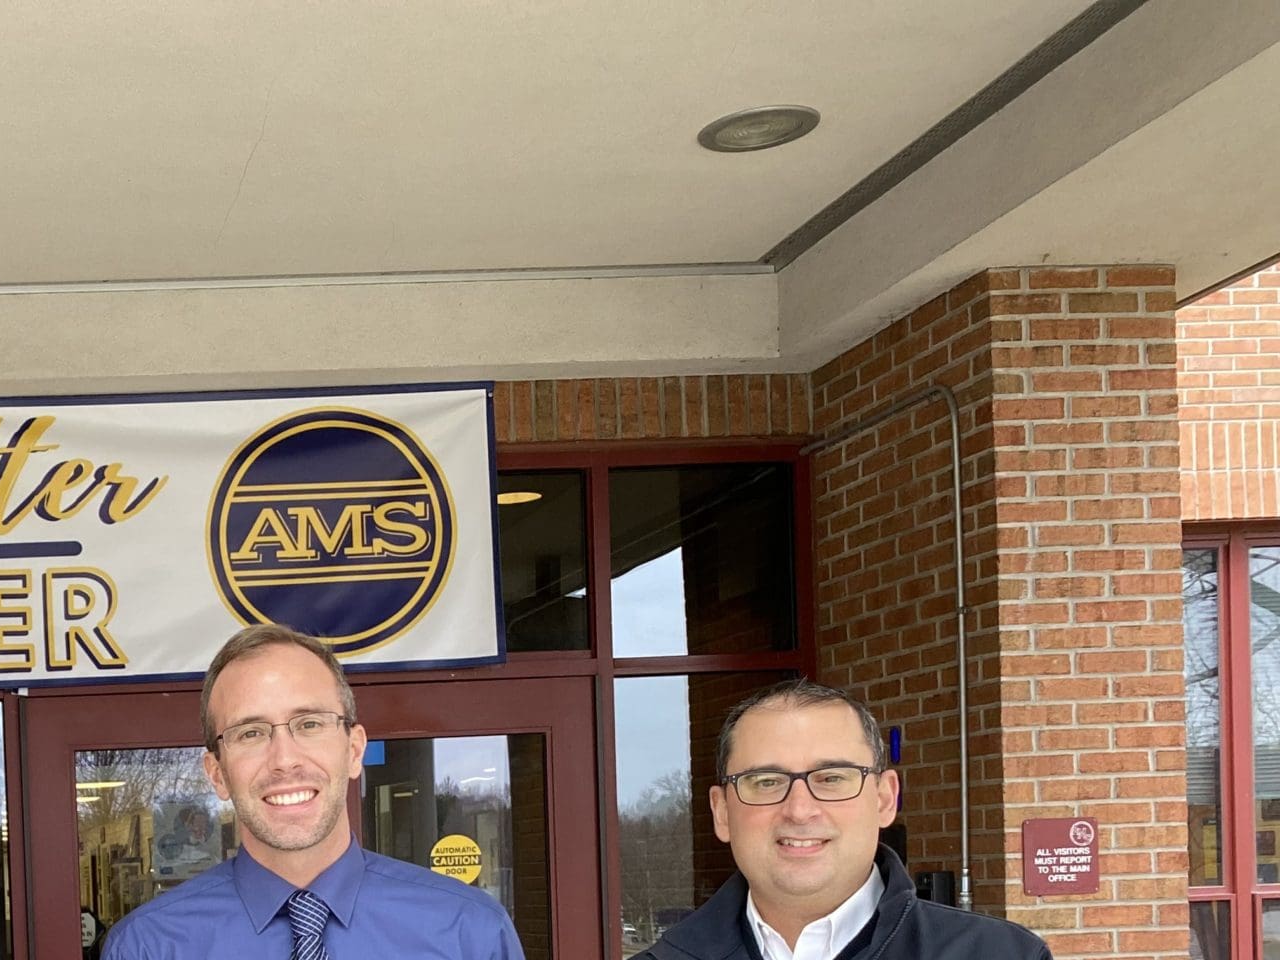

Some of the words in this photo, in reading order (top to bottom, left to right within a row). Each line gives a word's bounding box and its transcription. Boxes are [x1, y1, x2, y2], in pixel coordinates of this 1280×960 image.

[230, 501, 431, 564] AMS
[435, 846, 477, 854] AUTOMATIC
[1054, 847, 1090, 855] VISITORS
[433, 855, 479, 866] CAUTION
[1034, 857, 1057, 865] MUST
[1060, 855, 1092, 864] REPORT
[1038, 866, 1049, 874] TO
[1070, 865, 1090, 873] MAIN
[1048, 874, 1077, 882] OFFICE
